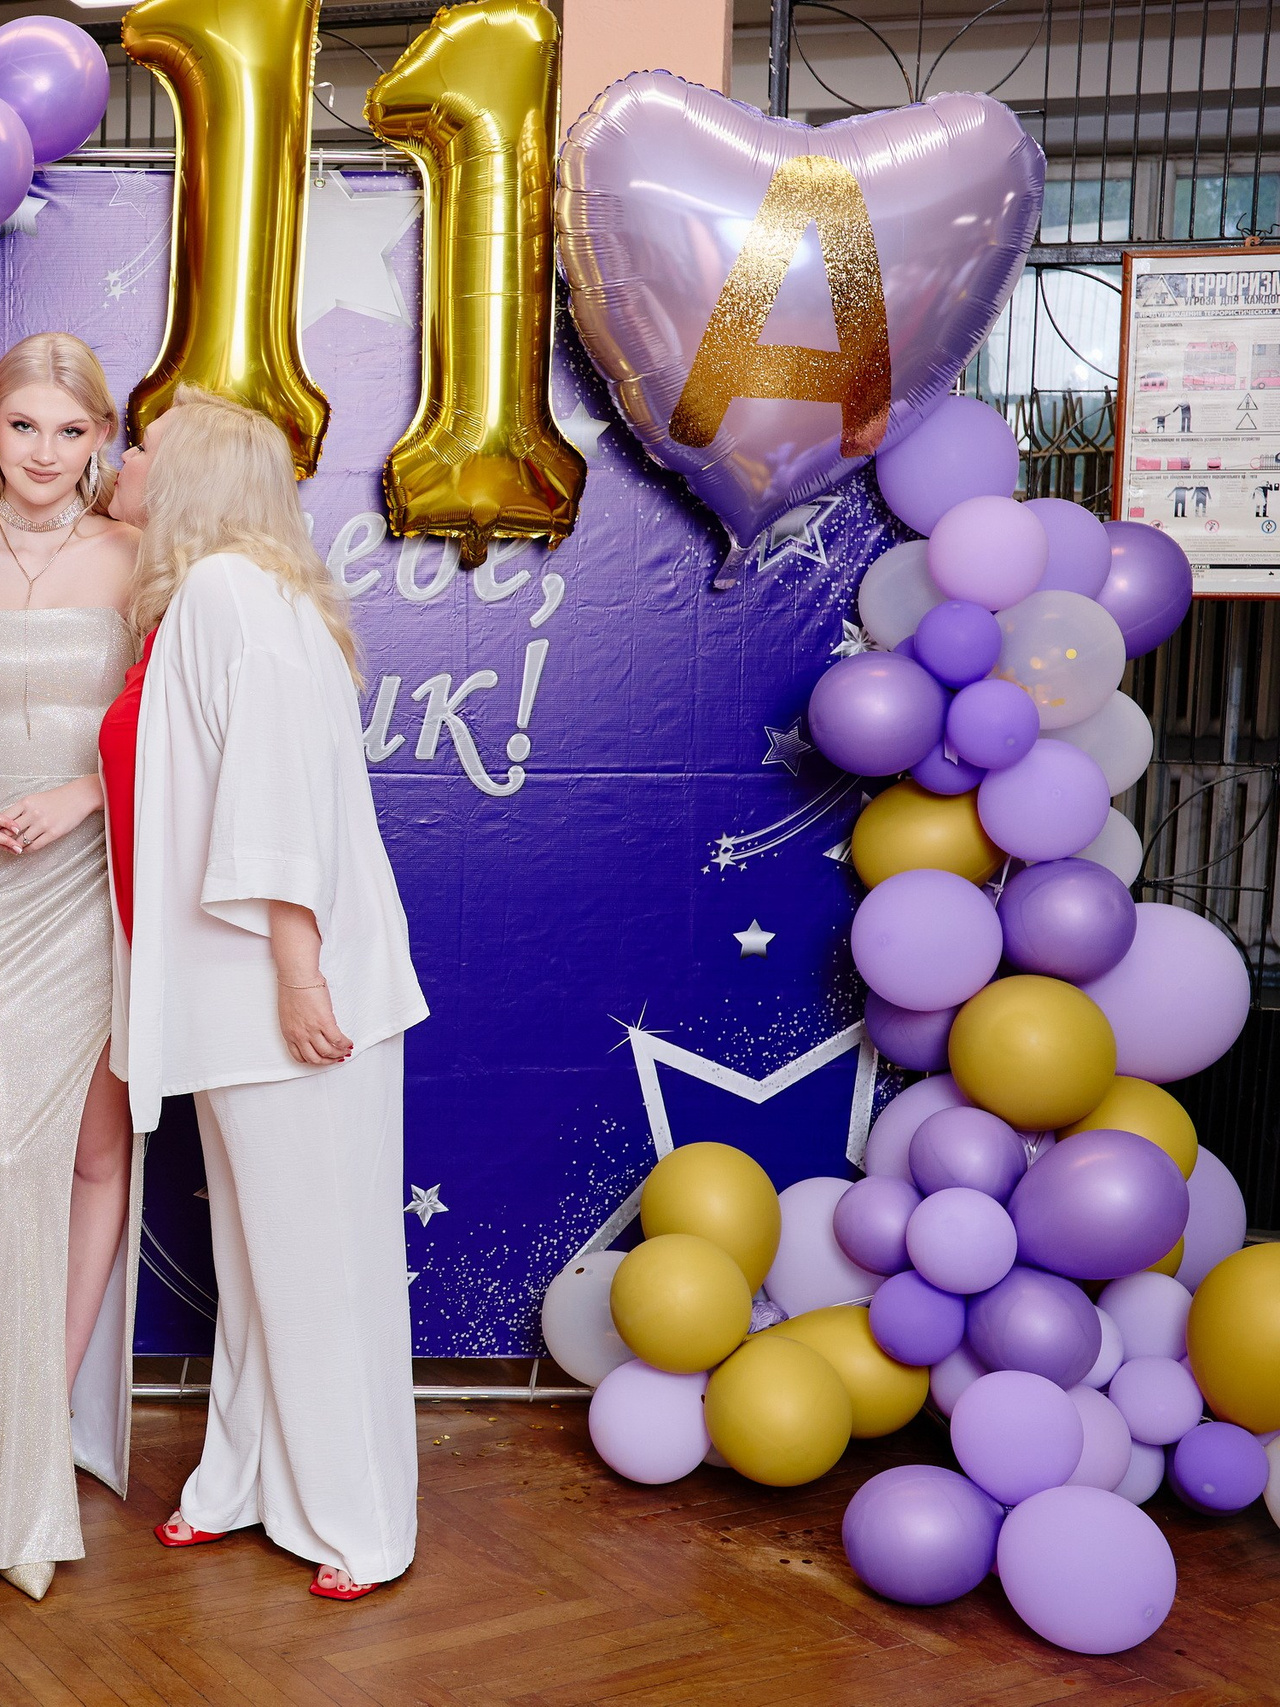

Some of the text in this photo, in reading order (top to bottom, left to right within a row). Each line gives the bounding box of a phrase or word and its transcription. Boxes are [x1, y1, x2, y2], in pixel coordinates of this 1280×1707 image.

[668, 154, 892, 459] А
[1184, 295, 1216, 306] УГРОЗА
[1220, 294, 1239, 307] ДЛЯ
[1205, 308, 1272, 317] ТЕРРОРИСТИЧЕСКИХ
